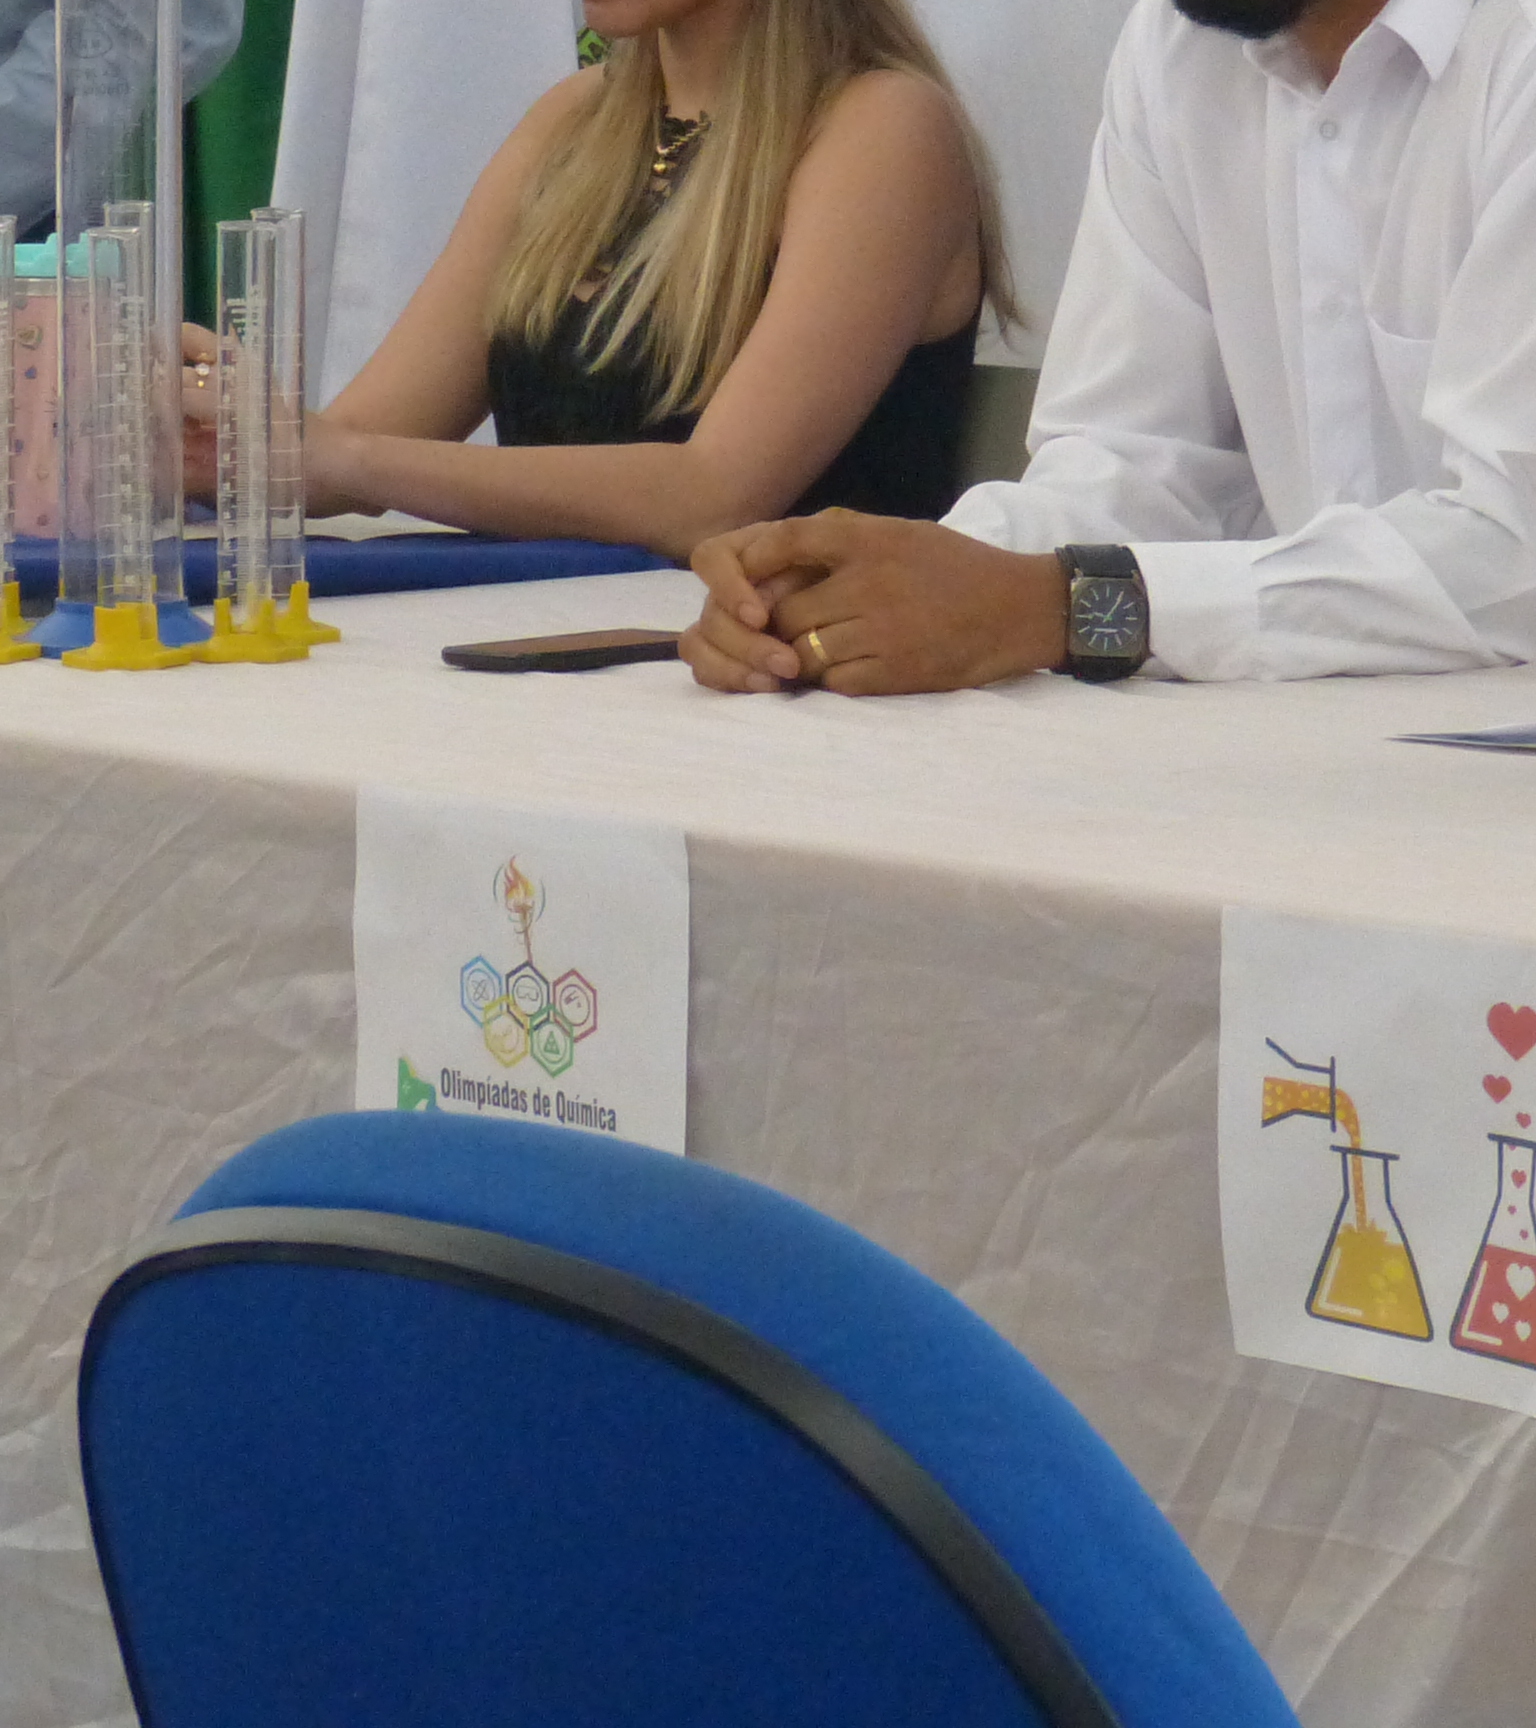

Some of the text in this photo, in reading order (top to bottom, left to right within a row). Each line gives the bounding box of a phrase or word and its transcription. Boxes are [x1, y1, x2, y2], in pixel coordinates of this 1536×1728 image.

[440, 1067, 617, 1133] Olimpíadas de Química
